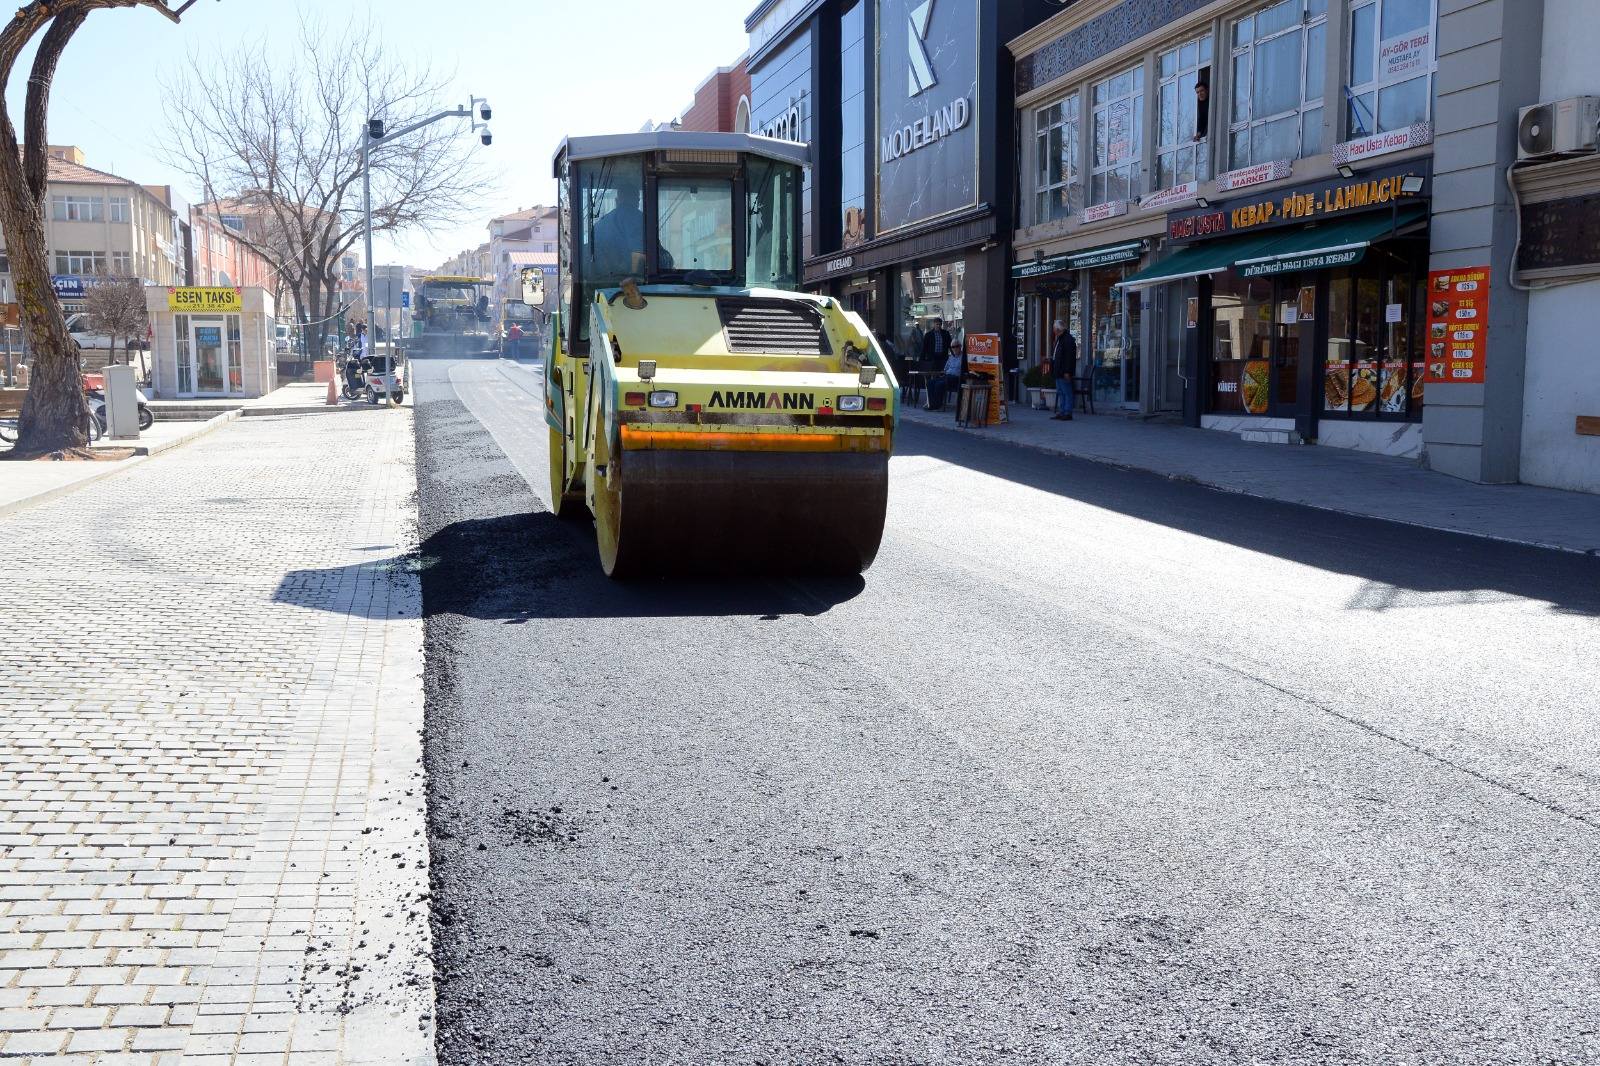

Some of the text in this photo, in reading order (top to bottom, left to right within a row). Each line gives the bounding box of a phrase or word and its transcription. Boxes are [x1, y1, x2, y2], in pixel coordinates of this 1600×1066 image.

[881, 97, 970, 163] MODELAND
[1349, 132, 1408, 156] Hacı Usta Kebap
[1232, 173, 1269, 188] MARKET
[1170, 215, 1195, 239] HACI
[1197, 211, 1226, 236] USTA
[1232, 201, 1274, 229] KEBAP
[1283, 191, 1315, 219] PİDE
[1325, 172, 1414, 213] LAHMACU
[826, 256, 854, 272] MODELAND
[1244, 261, 1282, 277] DÜRÜMCÜ
[1325, 251, 1356, 265] KEBAP
[176, 291, 202, 303] ESEN
[1217, 380, 1238, 392] KÜNEFE
[708, 390, 814, 409] AMMANN
